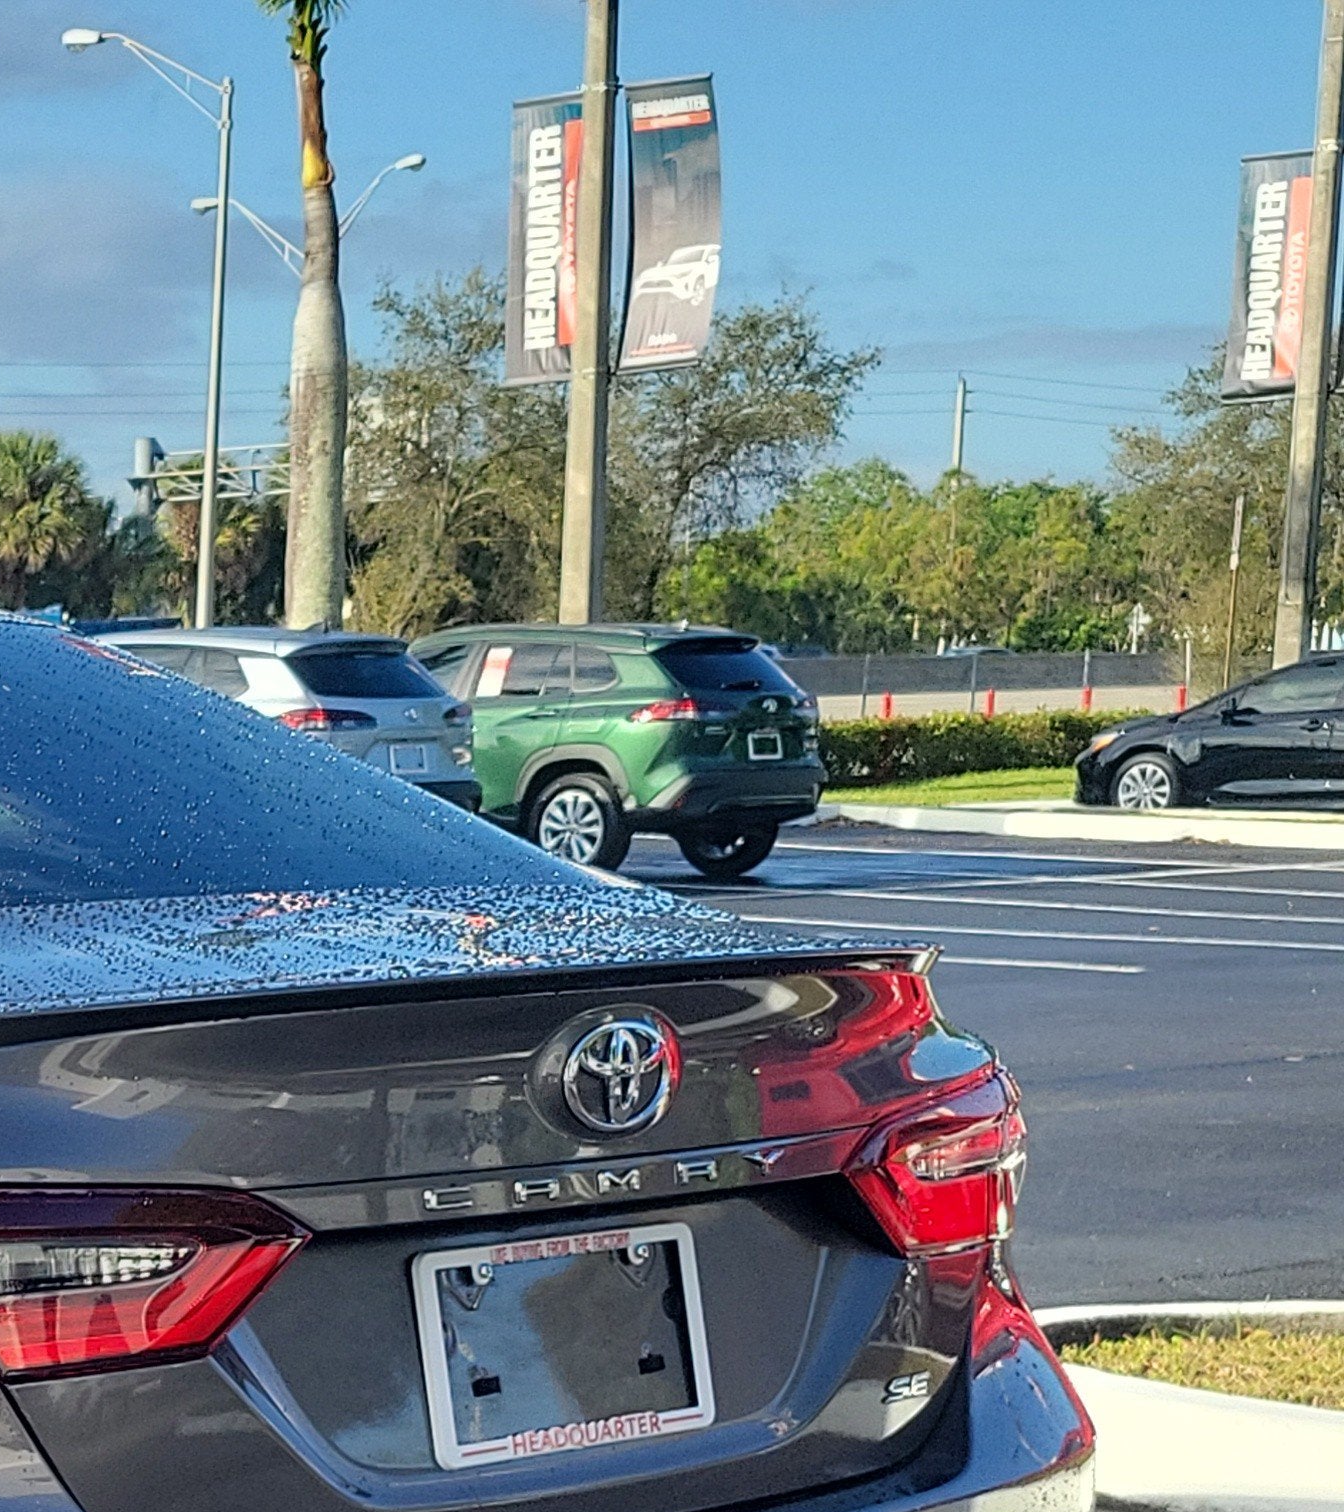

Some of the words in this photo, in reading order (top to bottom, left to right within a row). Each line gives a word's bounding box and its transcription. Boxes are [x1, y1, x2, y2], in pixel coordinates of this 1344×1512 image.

[523, 124, 561, 350] HEADQUARTER
[1285, 231, 1305, 305] TOYOTA
[1240, 180, 1288, 380] HEADQUARTER
[423, 1149, 785, 1211] CAMRY
[881, 1371, 930, 1404] SE
[512, 1415, 662, 1455] HEADQUARTER
